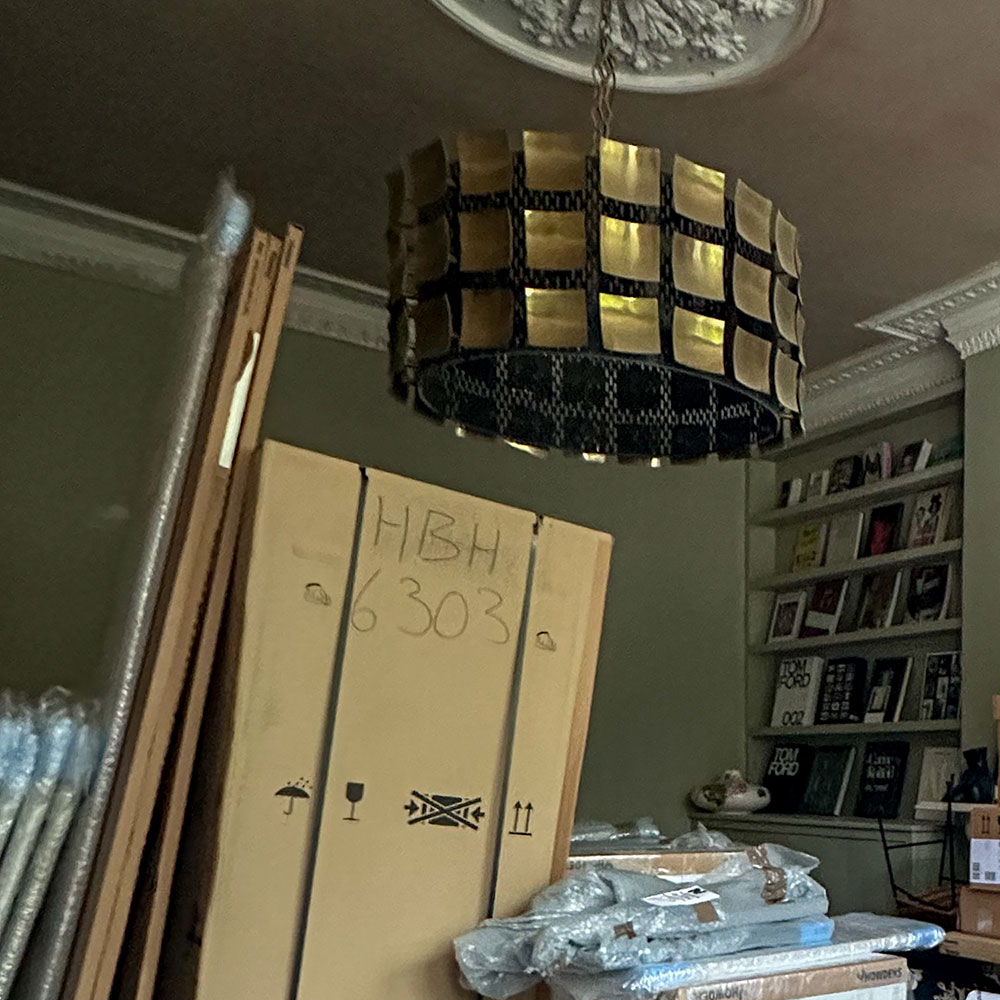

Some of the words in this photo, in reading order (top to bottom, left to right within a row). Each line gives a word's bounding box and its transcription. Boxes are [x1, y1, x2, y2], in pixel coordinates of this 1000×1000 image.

[373, 495, 500, 575] HBH
[350, 568, 511, 645] 6303
[780, 659, 807, 676] TOM
[777, 673, 811, 690] FORD
[774, 747, 800, 761] TOM
[767, 761, 800, 776] FORD
